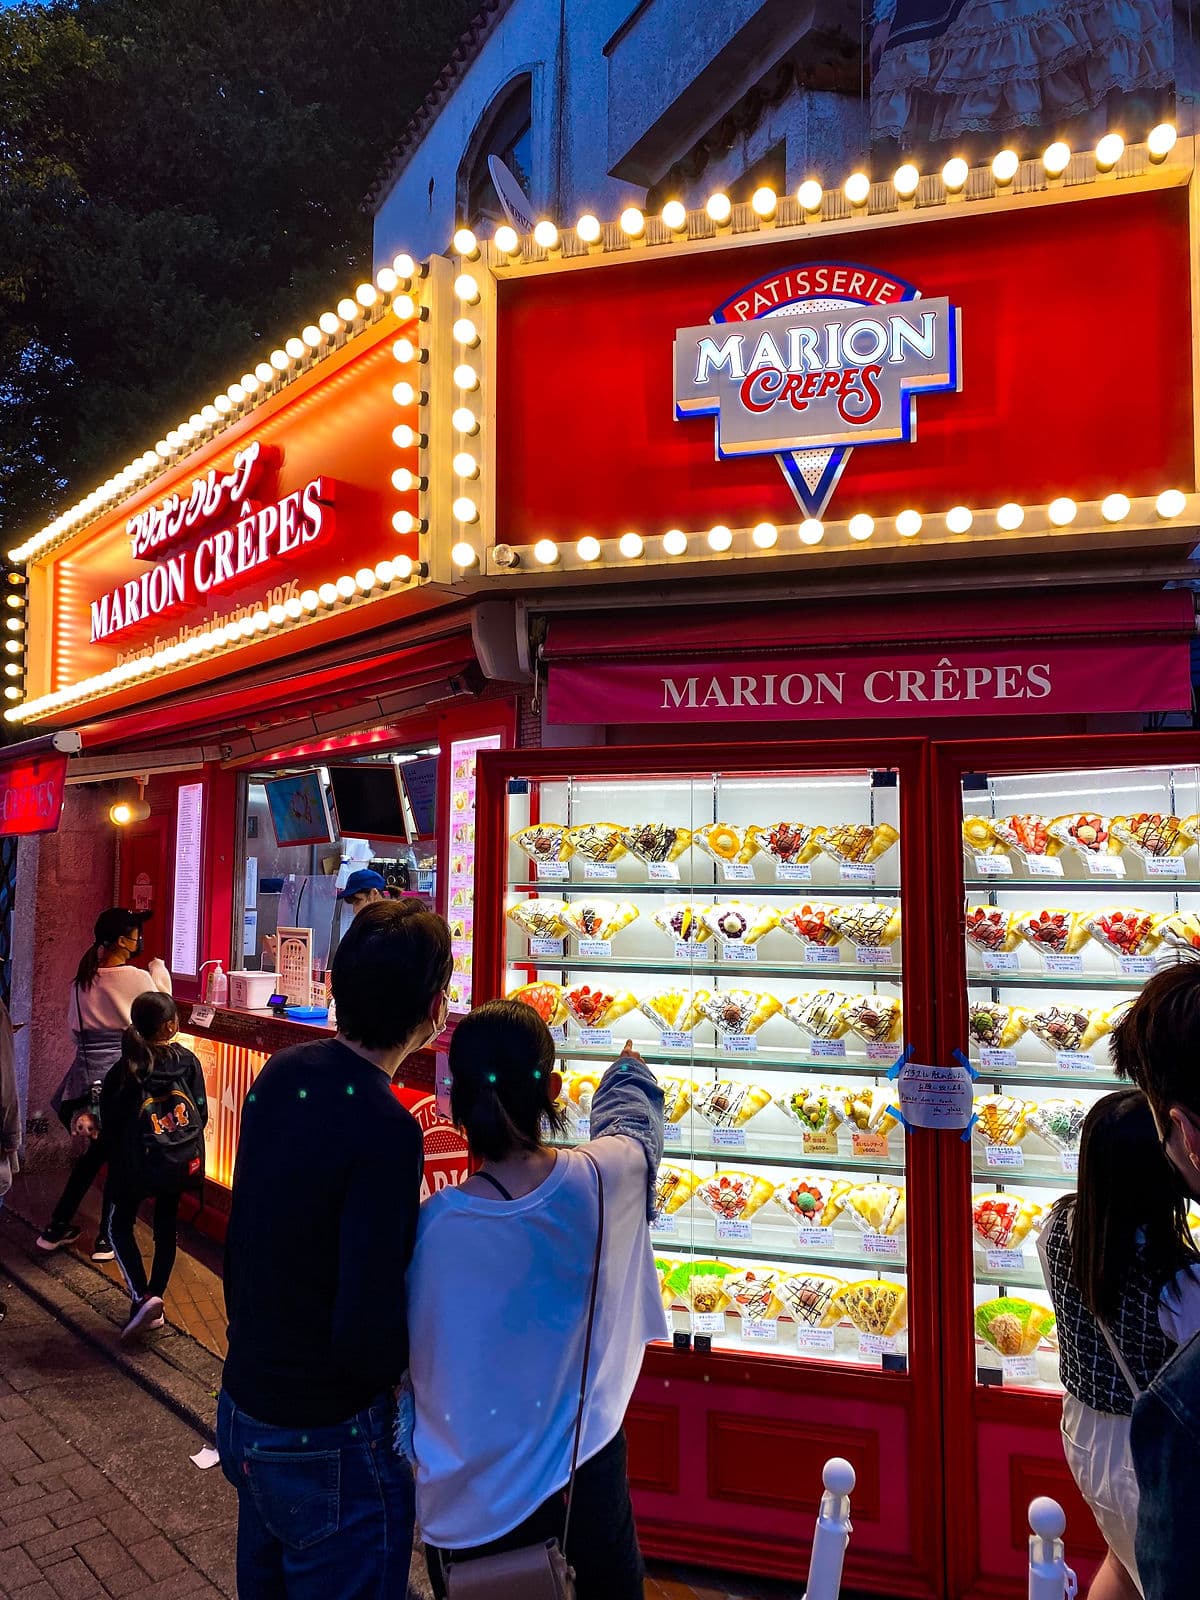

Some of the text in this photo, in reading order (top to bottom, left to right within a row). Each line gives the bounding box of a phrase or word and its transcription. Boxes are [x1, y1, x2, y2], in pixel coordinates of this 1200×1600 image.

[734, 269, 896, 320] PATISSERIE
[695, 312, 936, 382] MARION
[740, 365, 883, 425] CREPES
[126, 441, 260, 559] マリオンクレープ
[89, 475, 322, 643] MARION CRÊPES
[266, 578, 300, 609] 1976
[660, 657, 1052, 708] MARION CRÊPES
